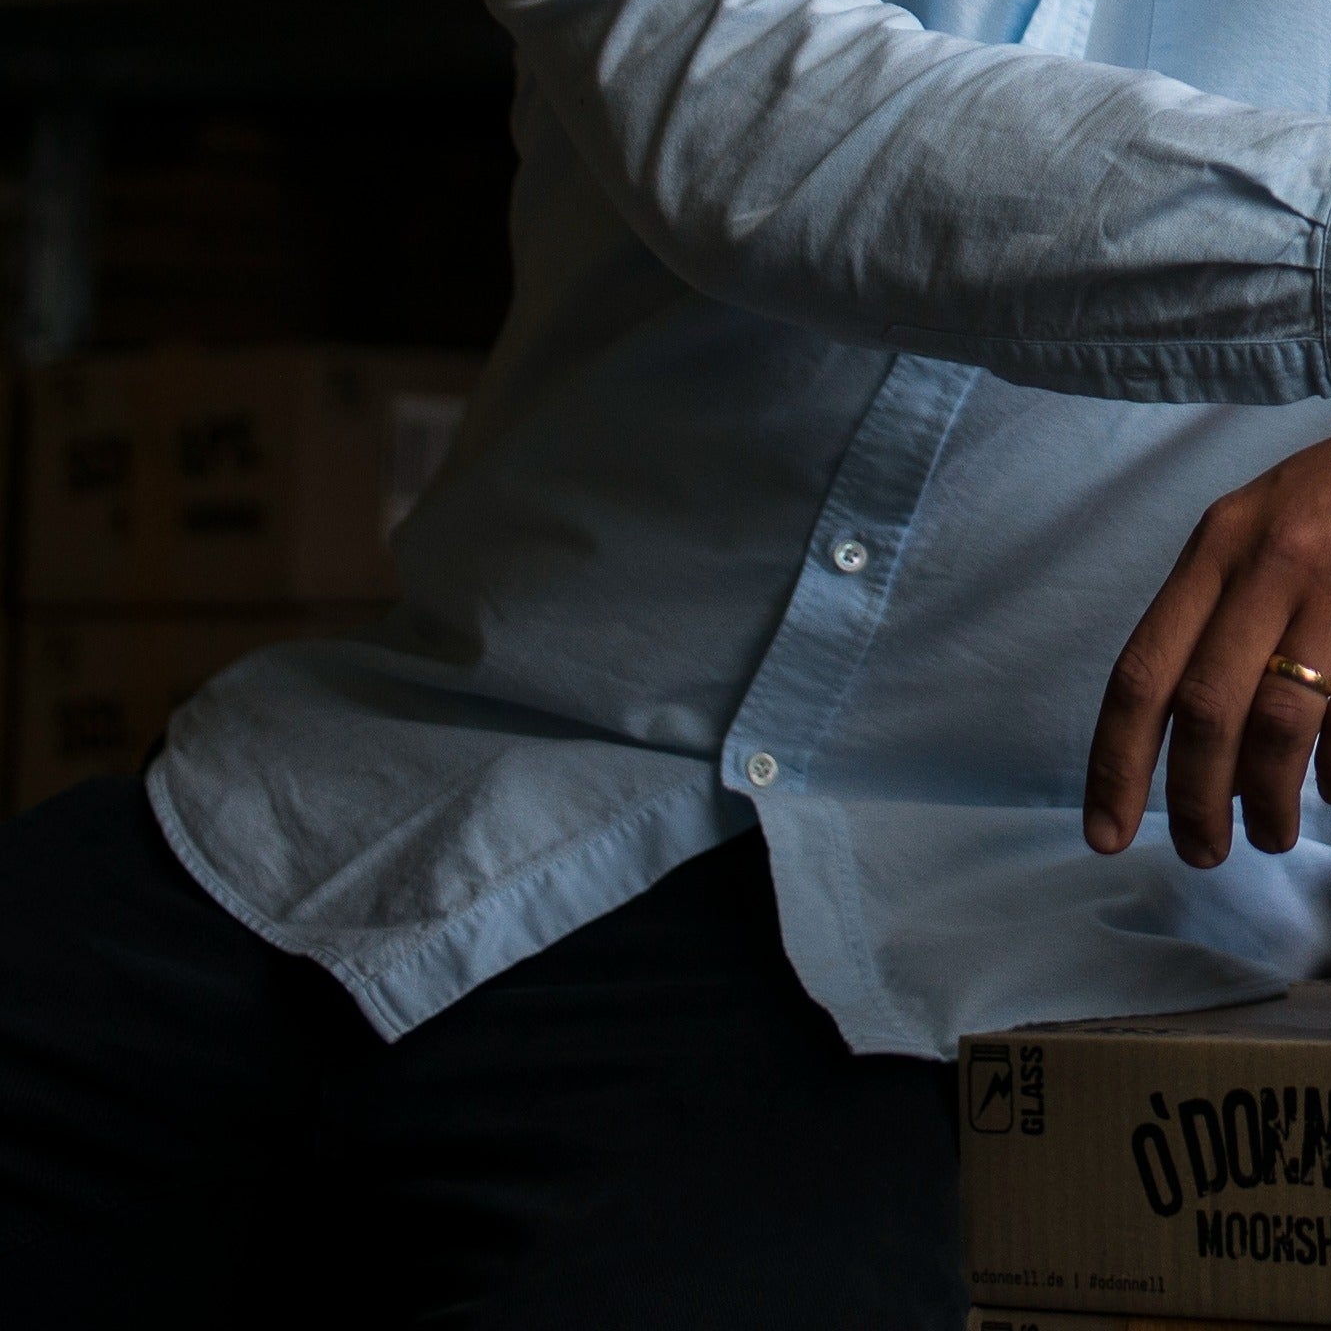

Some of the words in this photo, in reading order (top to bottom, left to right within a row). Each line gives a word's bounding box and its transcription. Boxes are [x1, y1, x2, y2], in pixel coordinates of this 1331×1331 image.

[1020, 1045, 1045, 1136] GLASS
[971, 1270, 1064, 1289] odonnell.de
[1088, 1275, 1166, 1294] #odonnell
